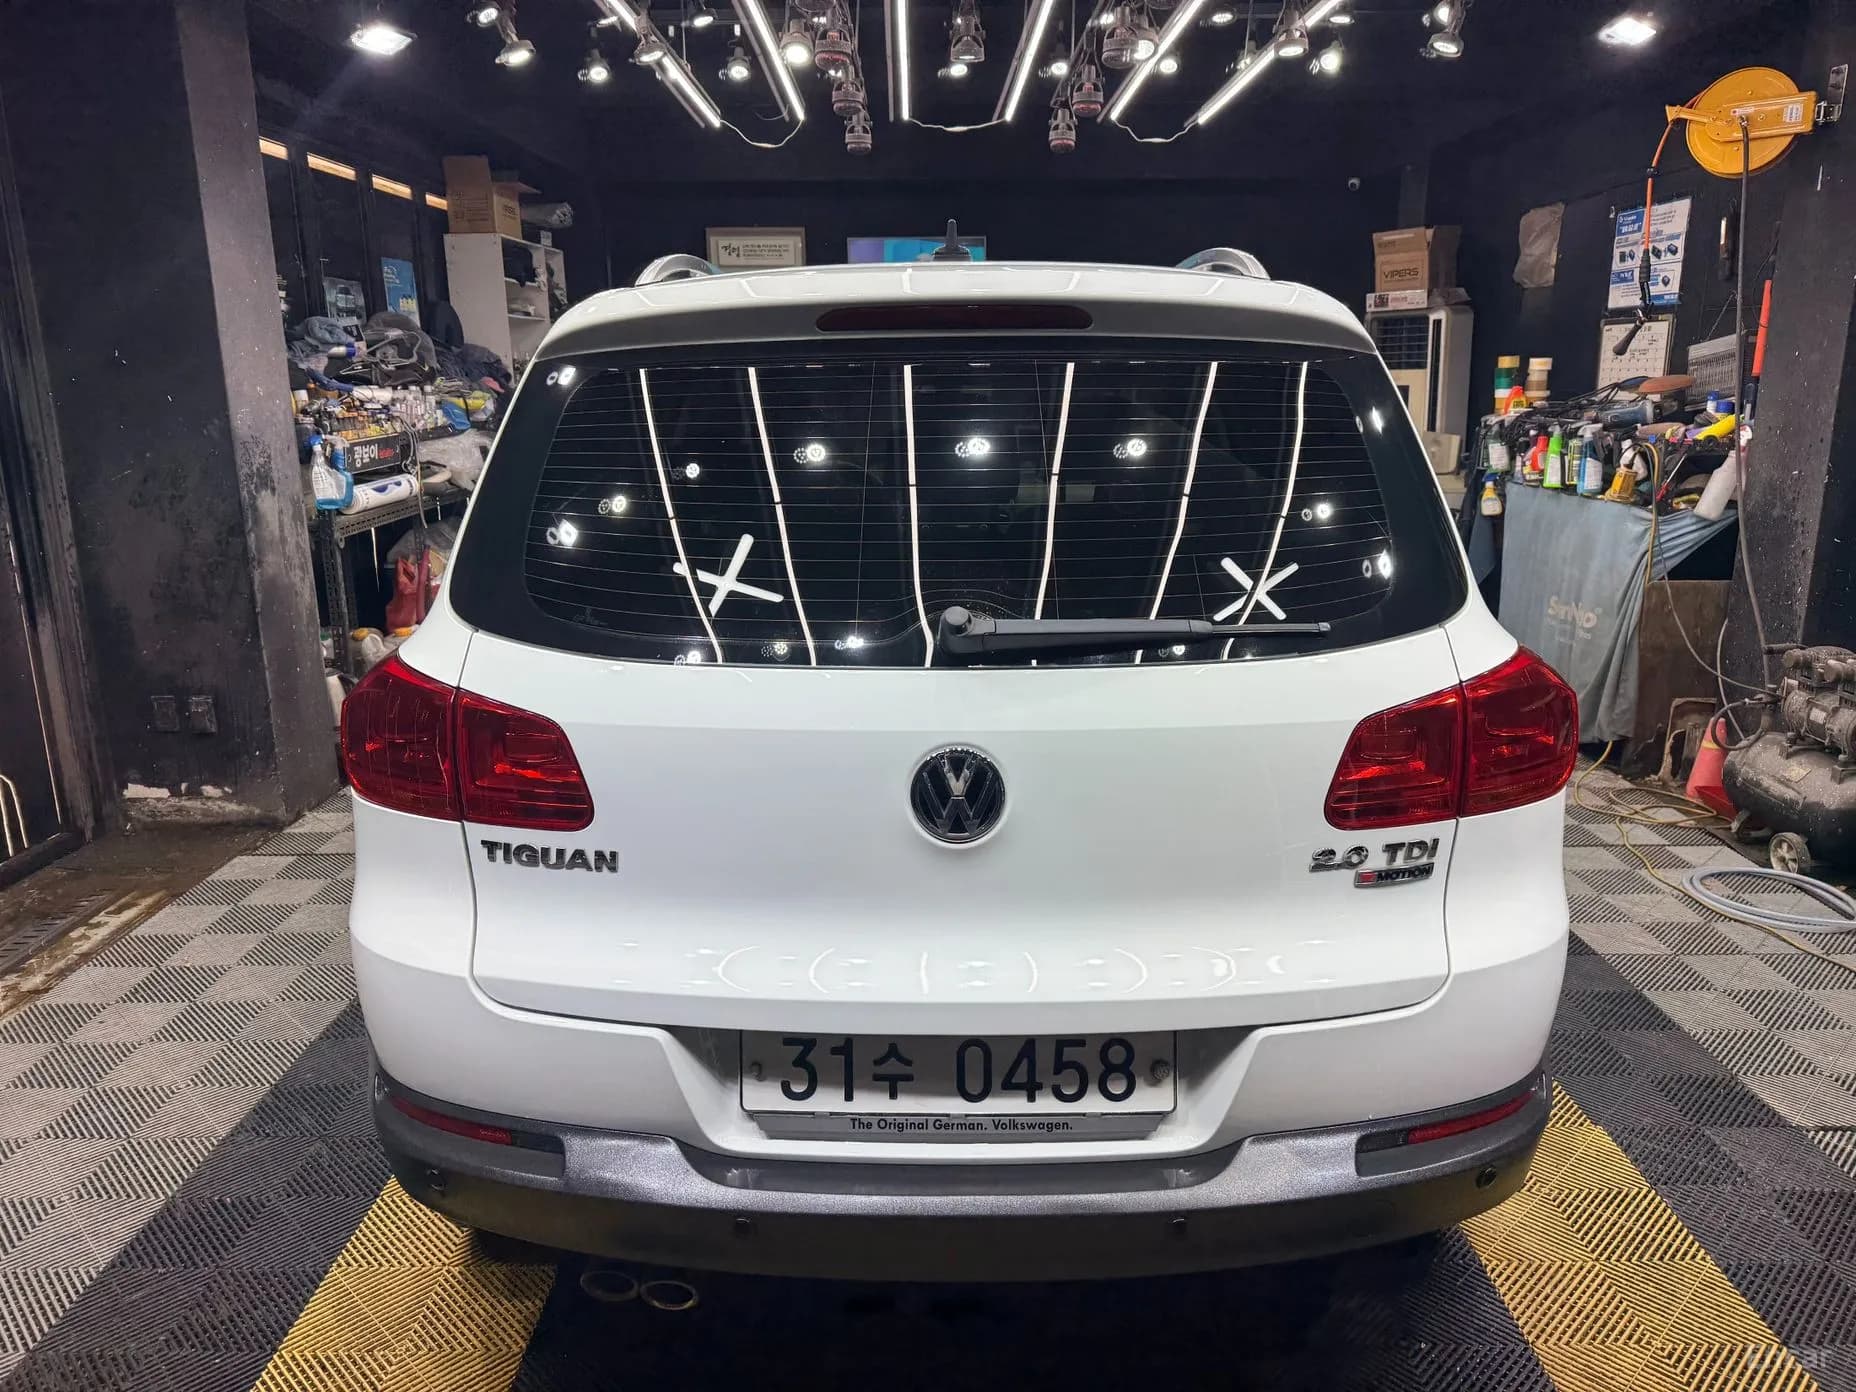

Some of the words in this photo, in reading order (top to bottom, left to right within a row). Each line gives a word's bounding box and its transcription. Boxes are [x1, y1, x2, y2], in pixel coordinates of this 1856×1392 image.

[1383, 267, 1419, 279] VIPERS
[481, 840, 619, 873] TIGUAN
[1309, 844, 1369, 873] 2.0
[1382, 838, 1440, 865] TDI
[1360, 865, 1432, 883] MOTION
[780, 1037, 915, 1102] 31수
[955, 1037, 1137, 1103] 0458
[850, 1118, 873, 1131] The
[876, 1117, 929, 1133] Original
[932, 1118, 988, 1132] German.
[992, 1118, 1074, 1133] Volkswagen.
